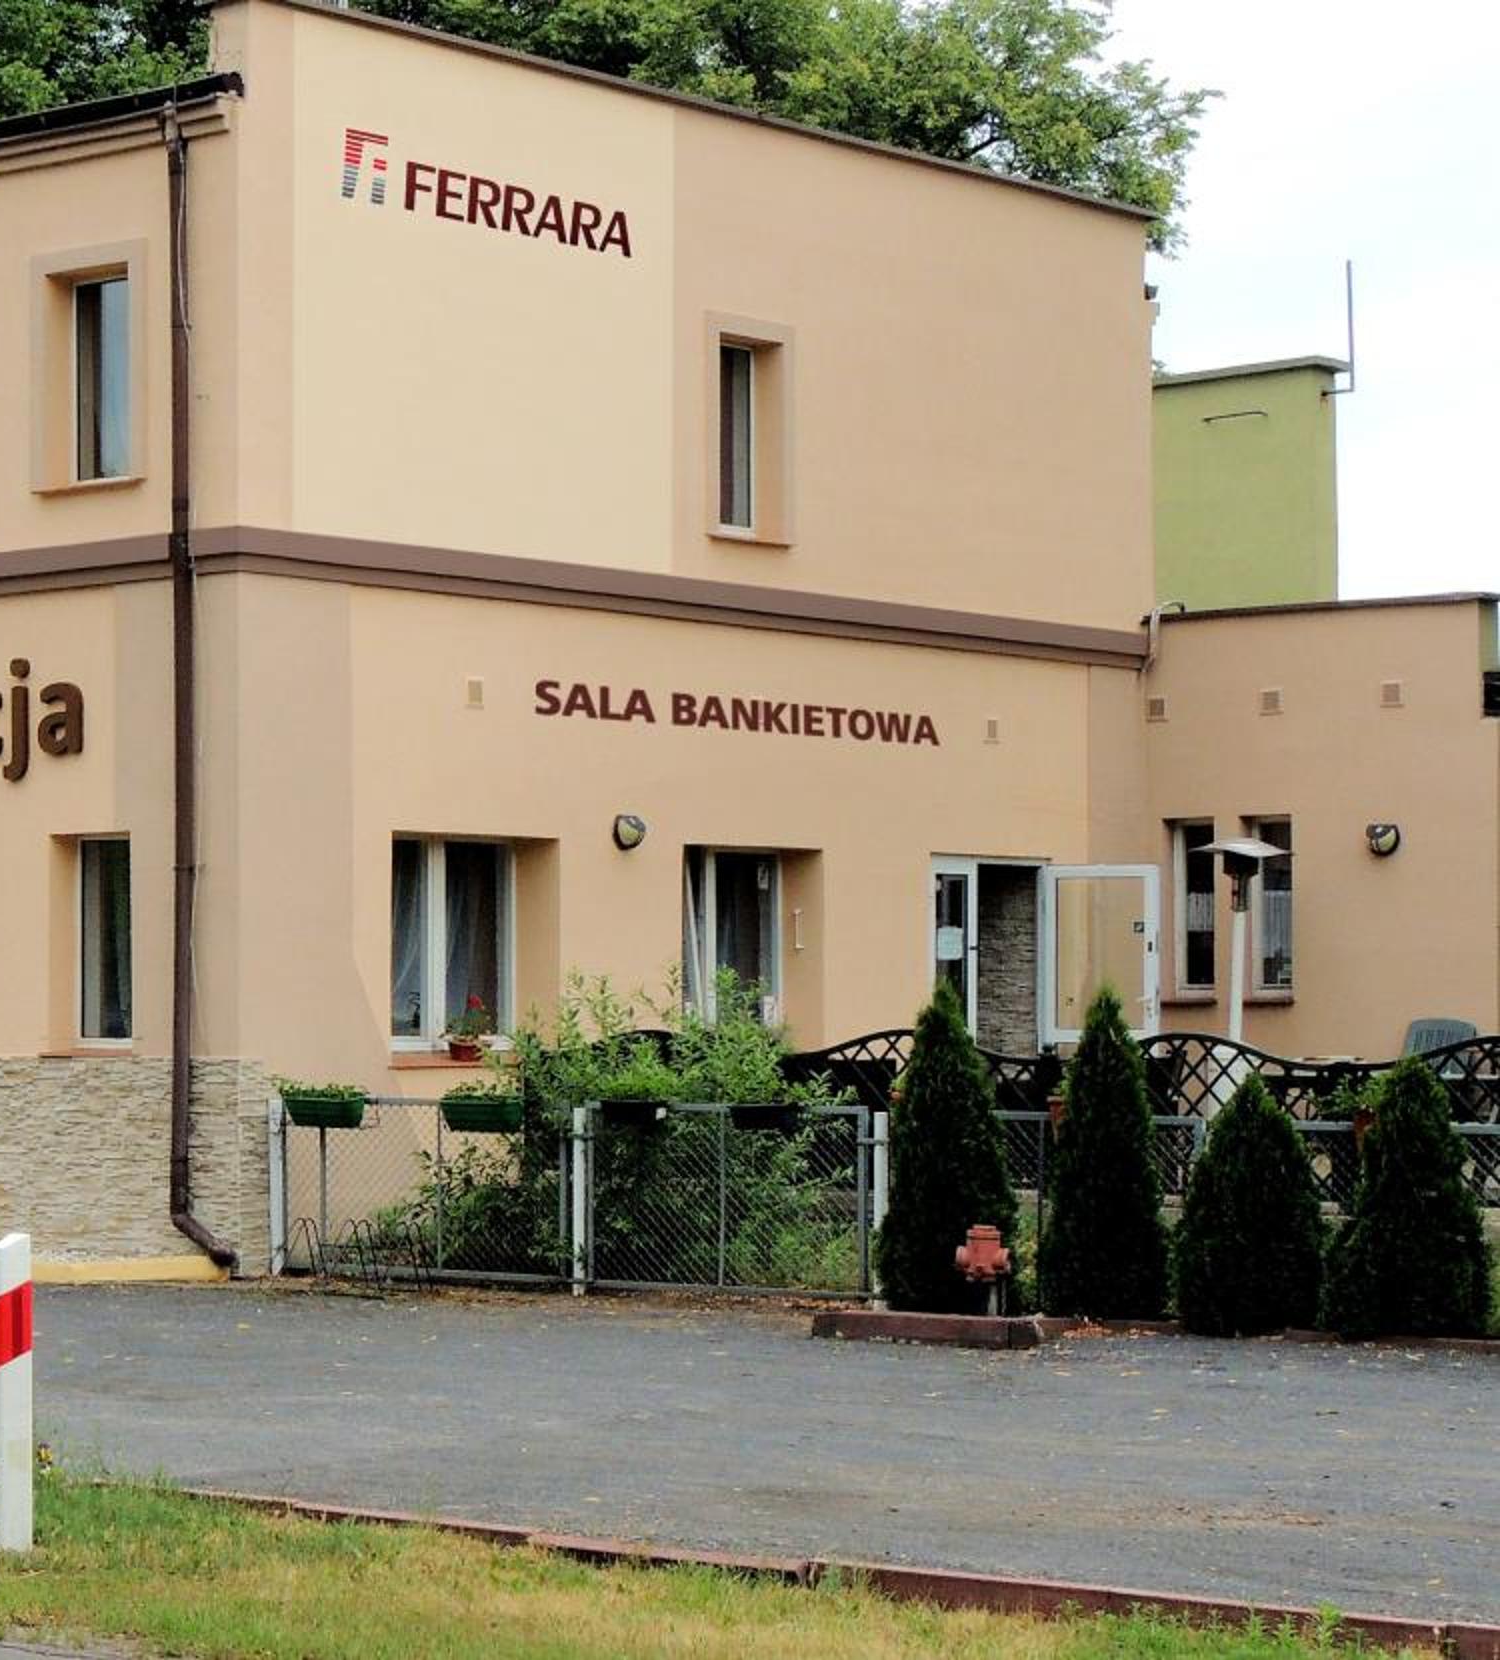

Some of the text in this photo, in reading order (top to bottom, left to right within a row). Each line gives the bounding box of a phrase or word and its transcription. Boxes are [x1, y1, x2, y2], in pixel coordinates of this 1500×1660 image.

[404, 161, 632, 259] FERRARA
[534, 679, 940, 747] SALA BANKIETOWA
